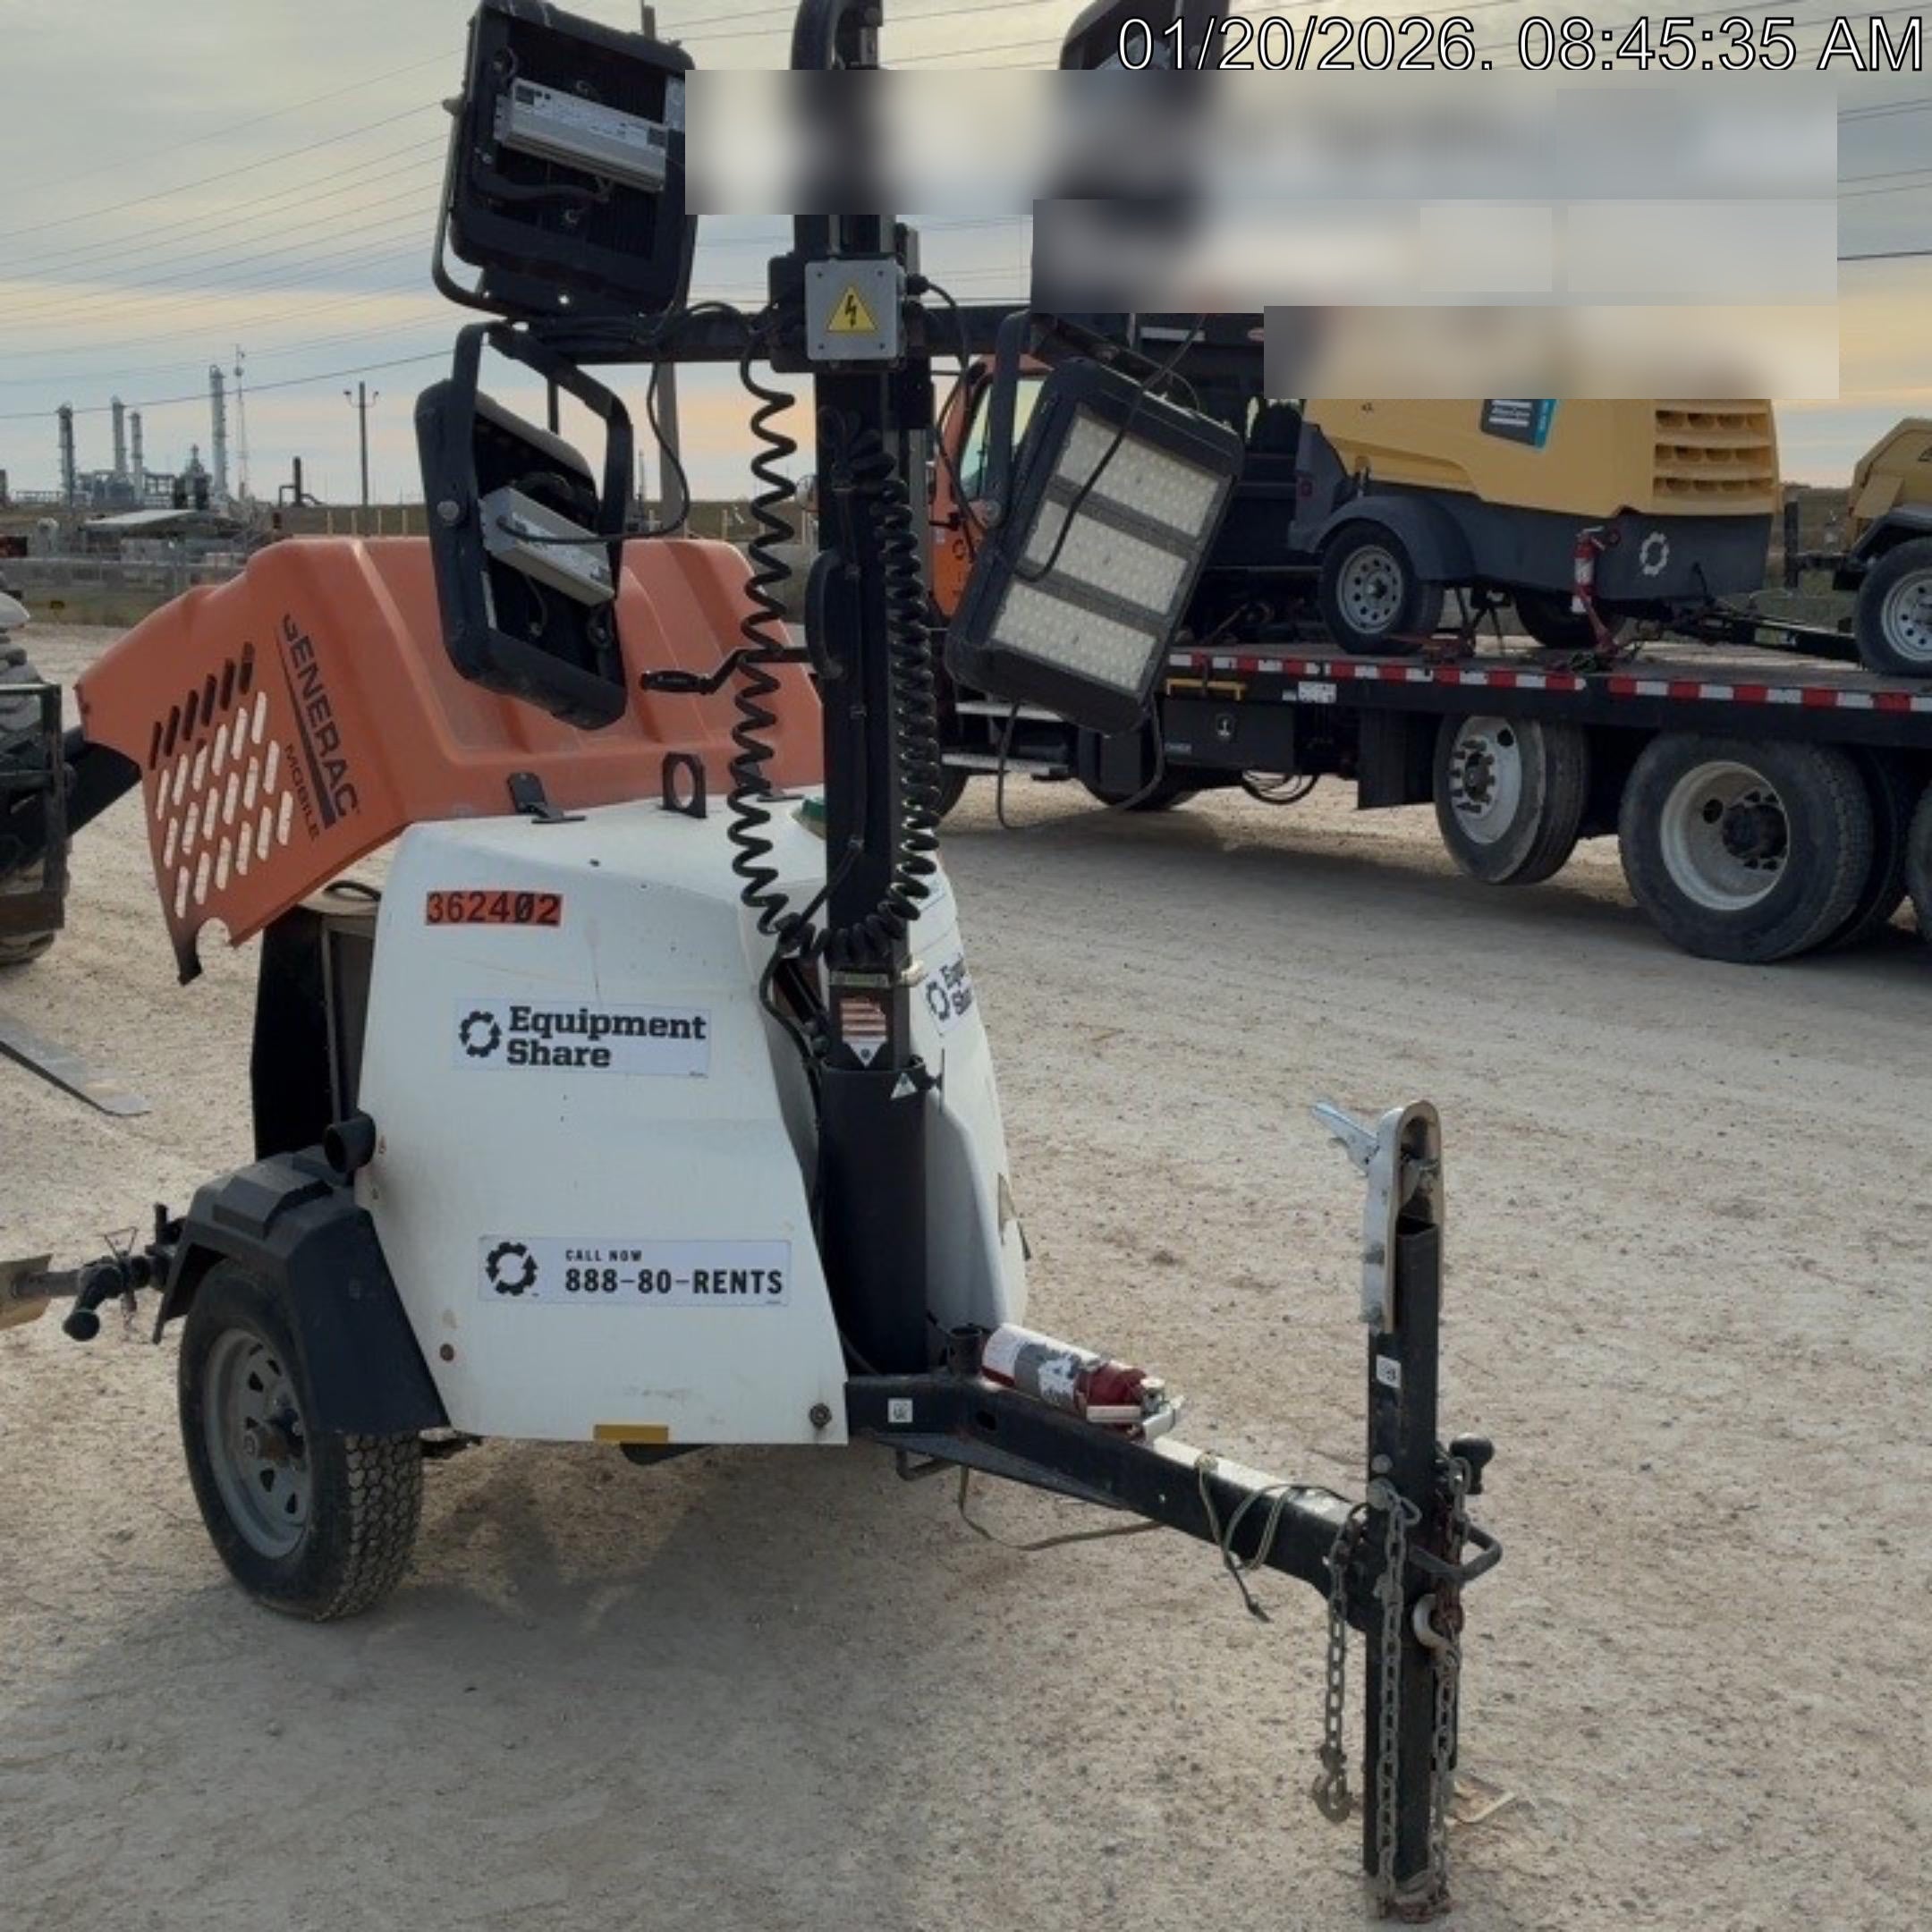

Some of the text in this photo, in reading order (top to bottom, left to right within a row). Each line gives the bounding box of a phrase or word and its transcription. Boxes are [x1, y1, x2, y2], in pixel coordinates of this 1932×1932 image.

[282, 614, 359, 818] GENERAC
[428, 892, 560, 924] 362402
[508, 1005, 707, 1041] Equipment
[506, 1038, 611, 1067] Share
[565, 1249, 642, 1263] CALL NOW
[565, 1268, 783, 1294] 888-80-RENTS
